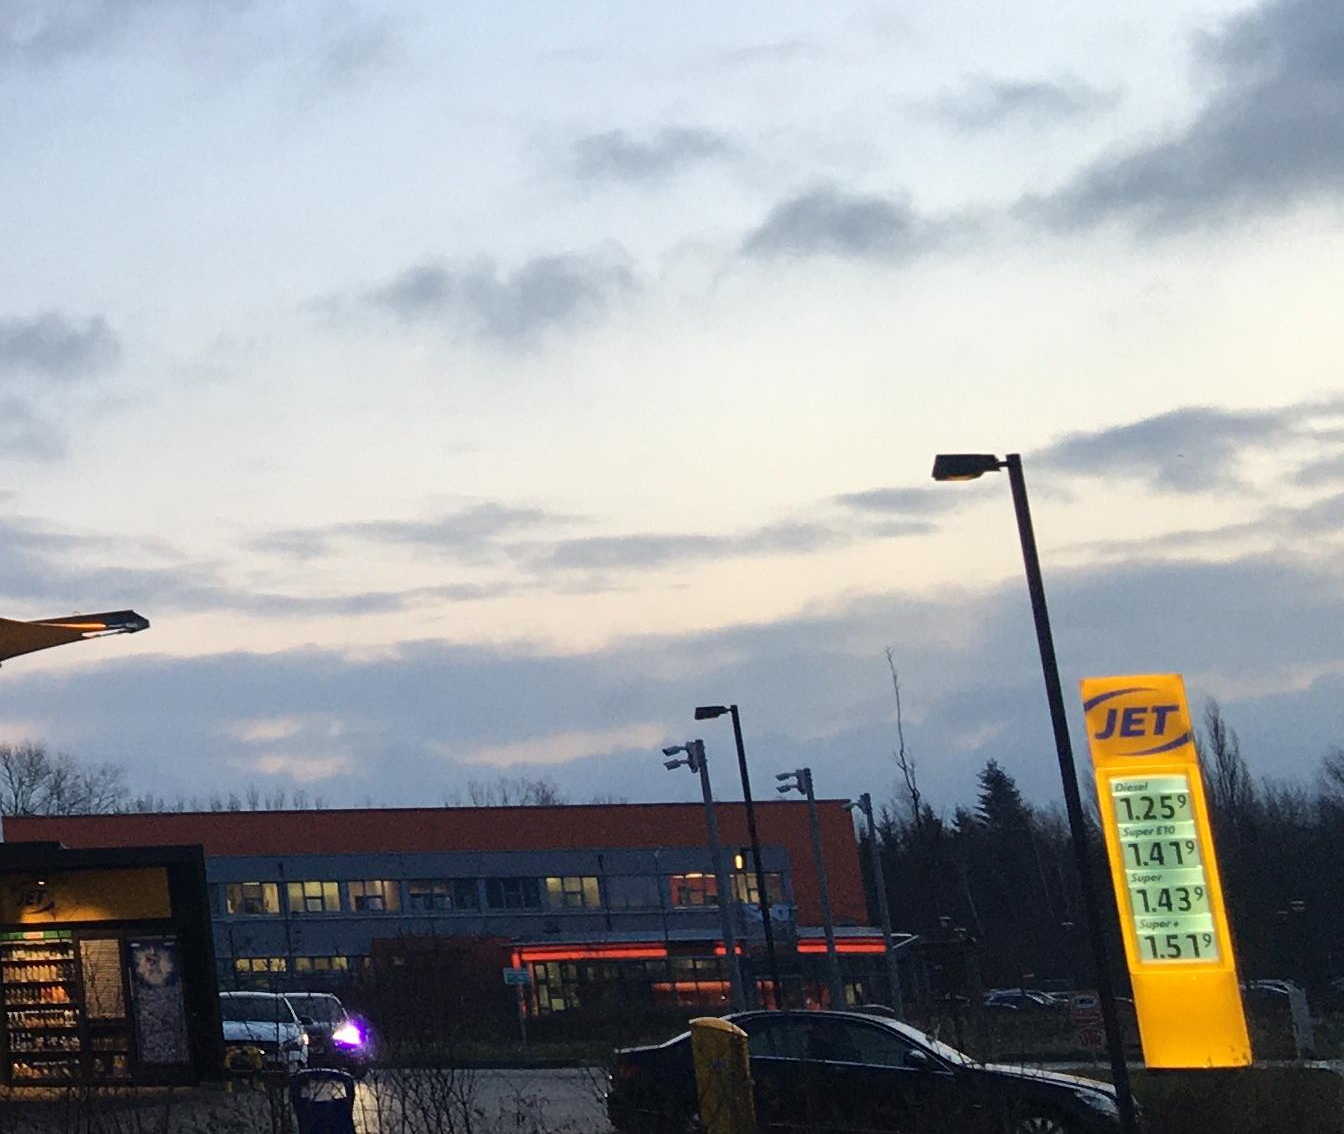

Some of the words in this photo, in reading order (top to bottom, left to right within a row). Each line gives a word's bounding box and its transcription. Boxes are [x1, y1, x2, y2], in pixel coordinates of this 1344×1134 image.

[1094, 705, 1179, 740] JET
[1115, 782, 1149, 792] Diesel
[1123, 827, 1154, 838] Super
[1156, 825, 1175, 835] E10
[1131, 873, 1162, 884] Super
[1139, 919, 1171, 929] Super
